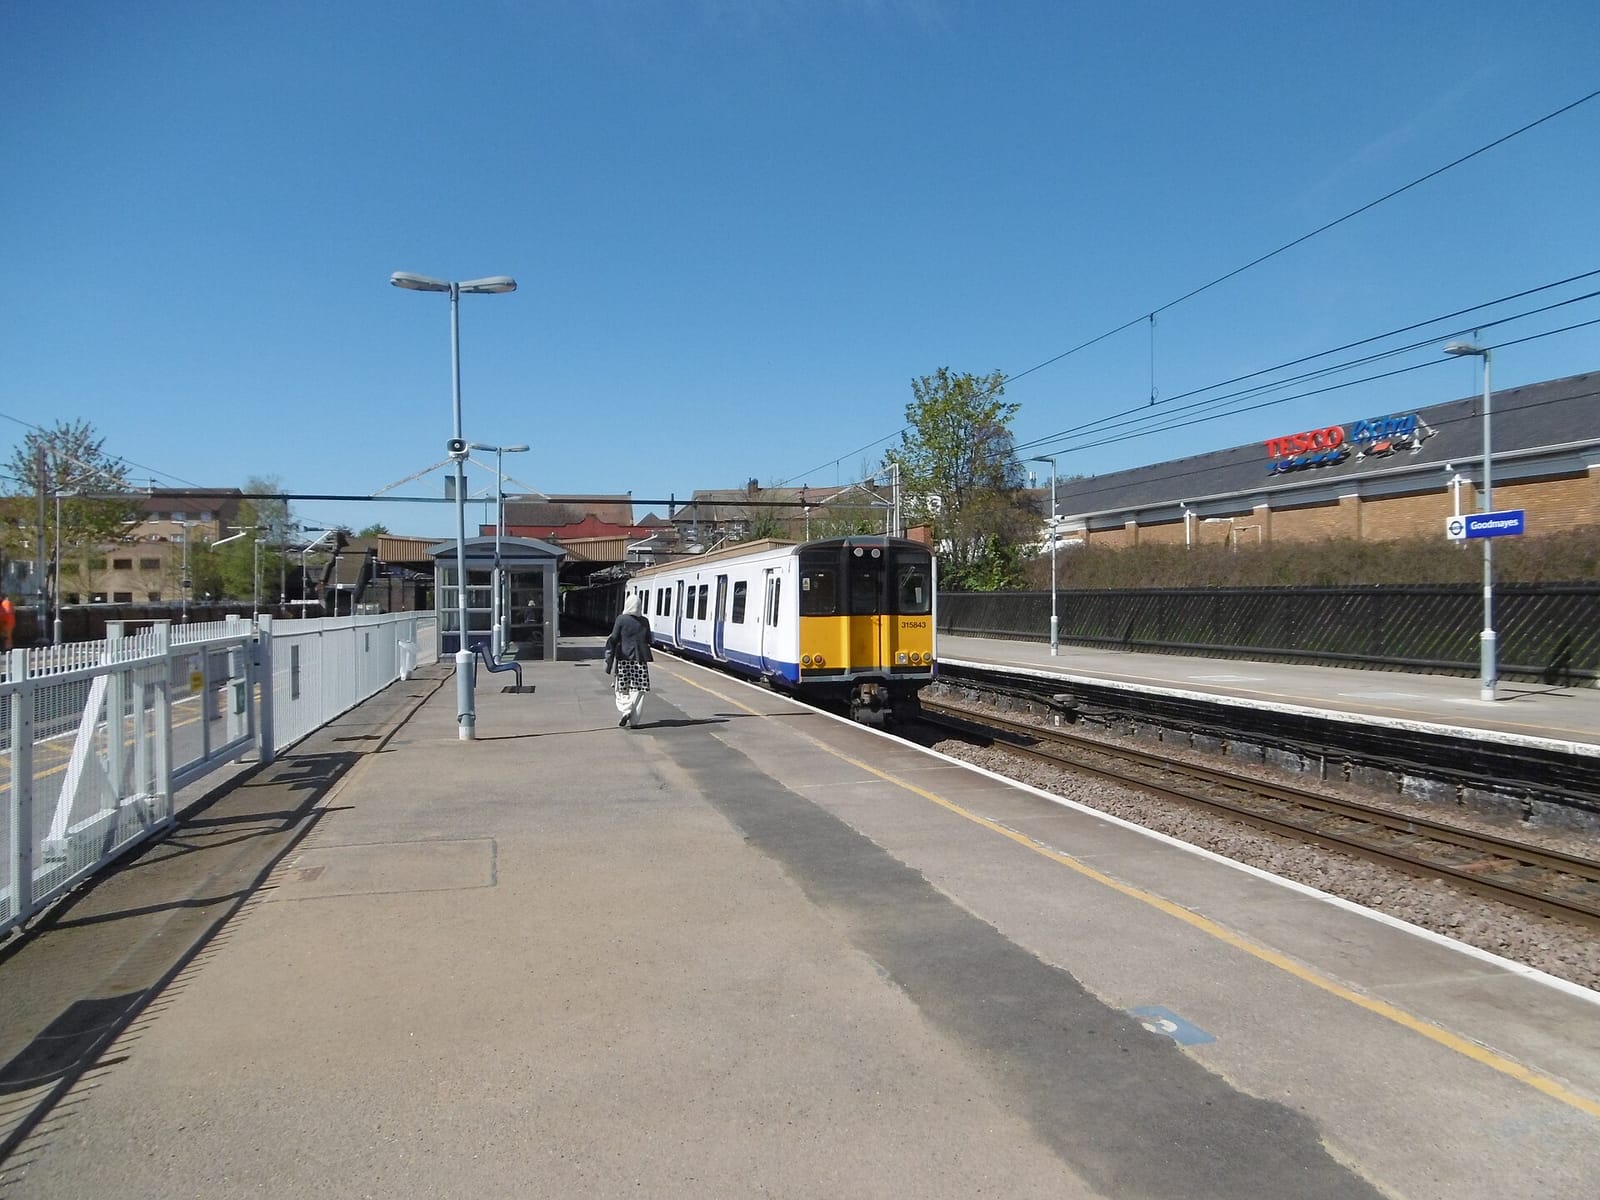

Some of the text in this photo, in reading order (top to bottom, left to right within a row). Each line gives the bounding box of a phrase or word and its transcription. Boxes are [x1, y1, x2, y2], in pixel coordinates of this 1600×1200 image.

[1264, 425, 1344, 458] TESCO
[1470, 518, 1519, 530] Goodmayes
[901, 621, 927, 629] 315843
